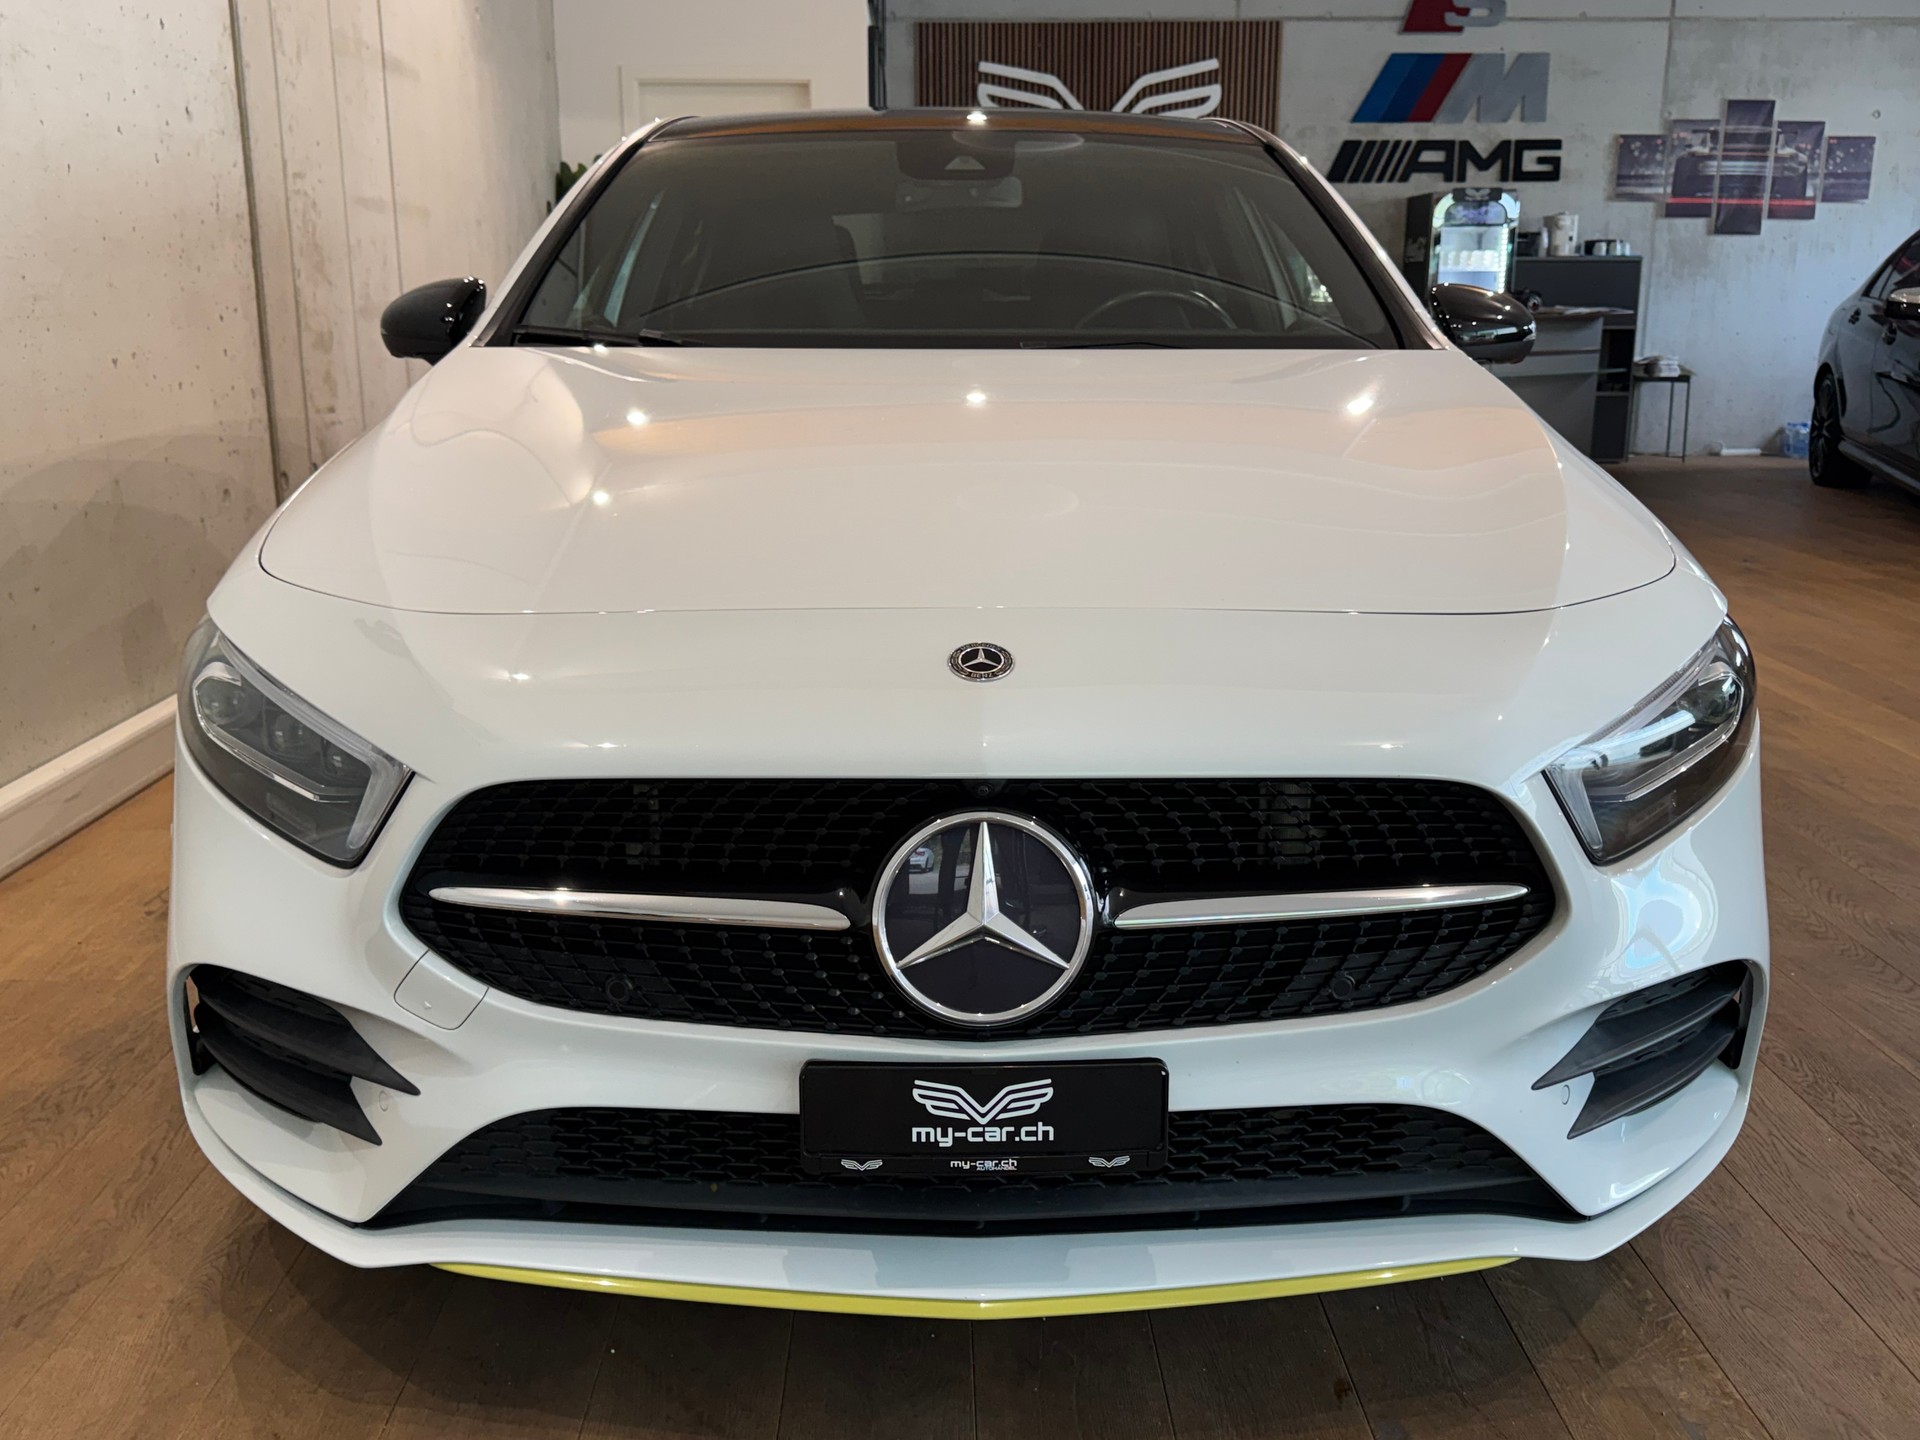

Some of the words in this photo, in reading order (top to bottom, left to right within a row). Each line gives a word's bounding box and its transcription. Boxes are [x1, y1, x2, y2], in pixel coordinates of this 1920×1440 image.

[1398, 139, 1562, 182] AMG
[912, 1122, 1054, 1147] my-car.ch
[950, 1158, 1017, 1169] my-car.ch
